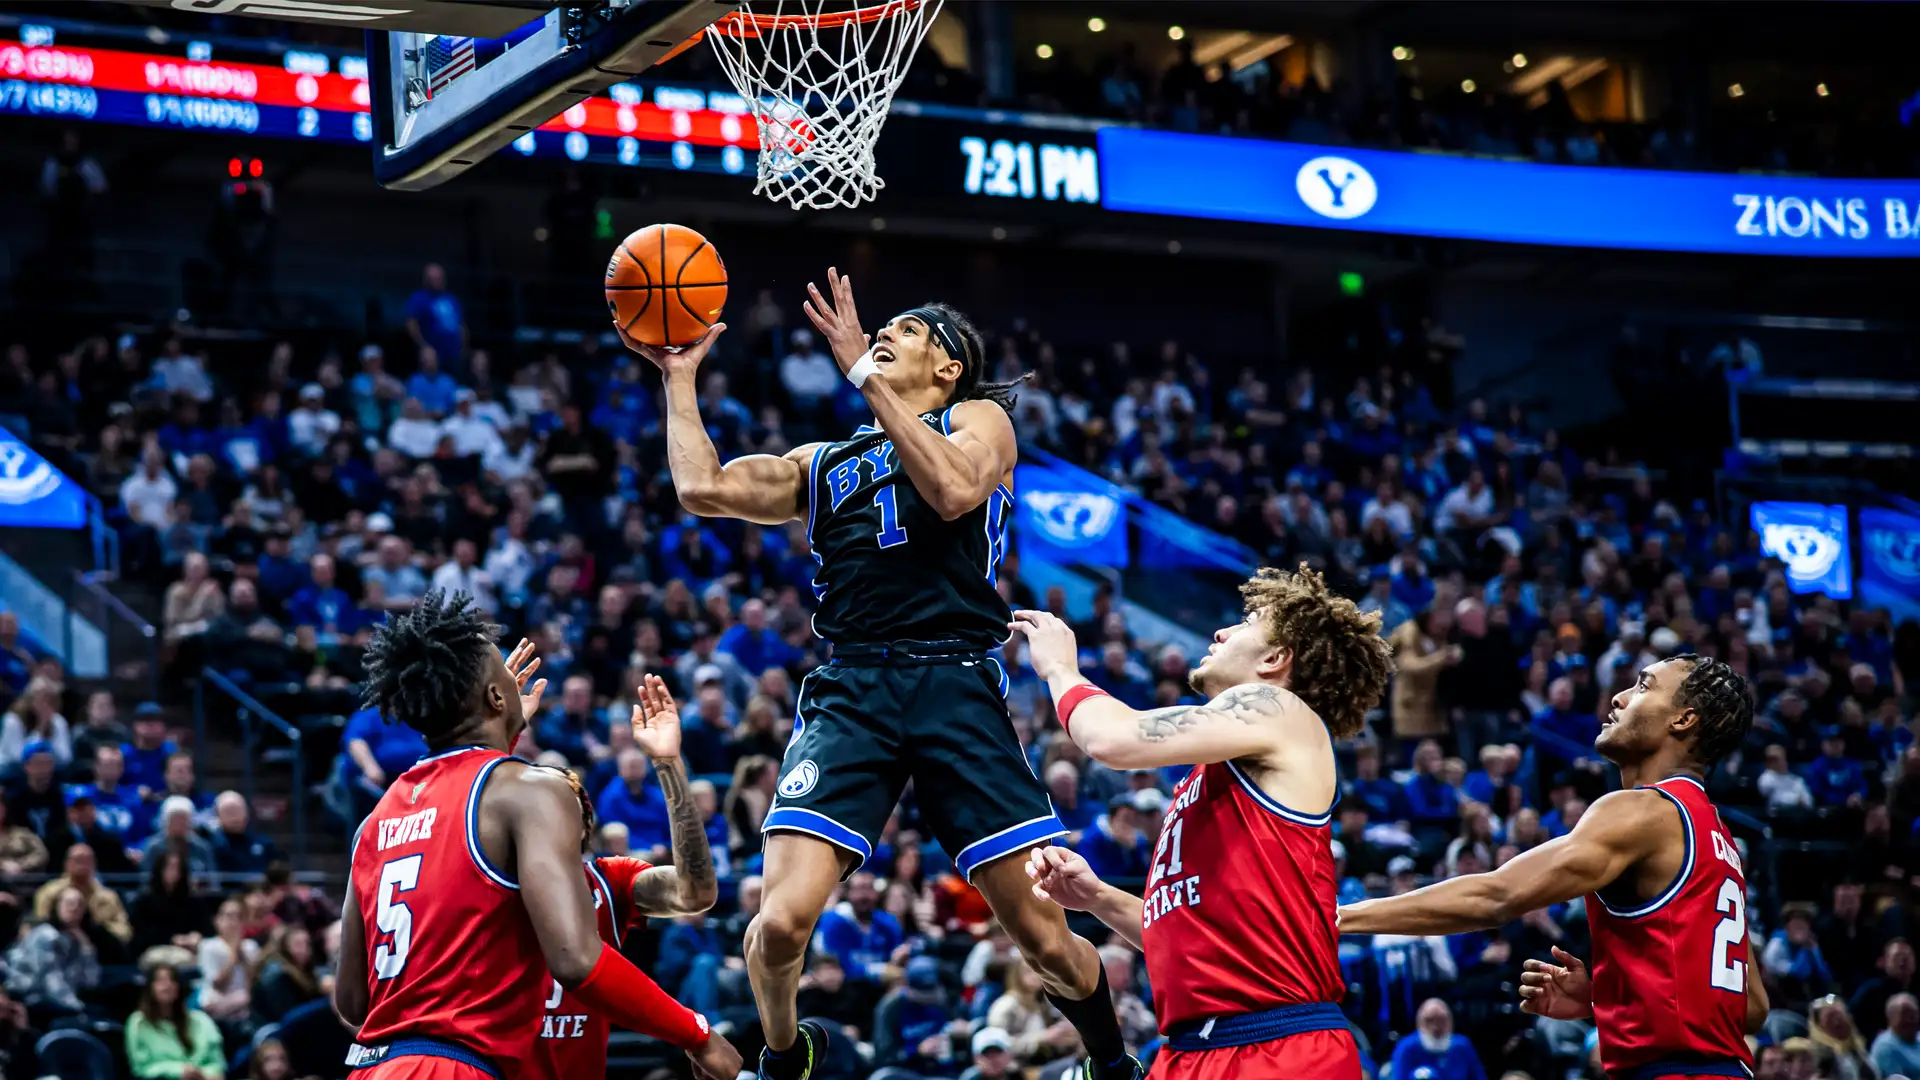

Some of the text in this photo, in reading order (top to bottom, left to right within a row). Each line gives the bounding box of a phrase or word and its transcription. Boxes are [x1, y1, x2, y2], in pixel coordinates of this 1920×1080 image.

[960, 137, 1099, 204] 7:21 PM
[1317, 167, 1357, 207] Y
[1733, 193, 1869, 240] ZIONS
[874, 483, 908, 549] 1
[377, 807, 437, 851] WEAVER
[1149, 816, 1184, 889] 21
[374, 852, 424, 982] 5
[1143, 874, 1201, 929] STATE
